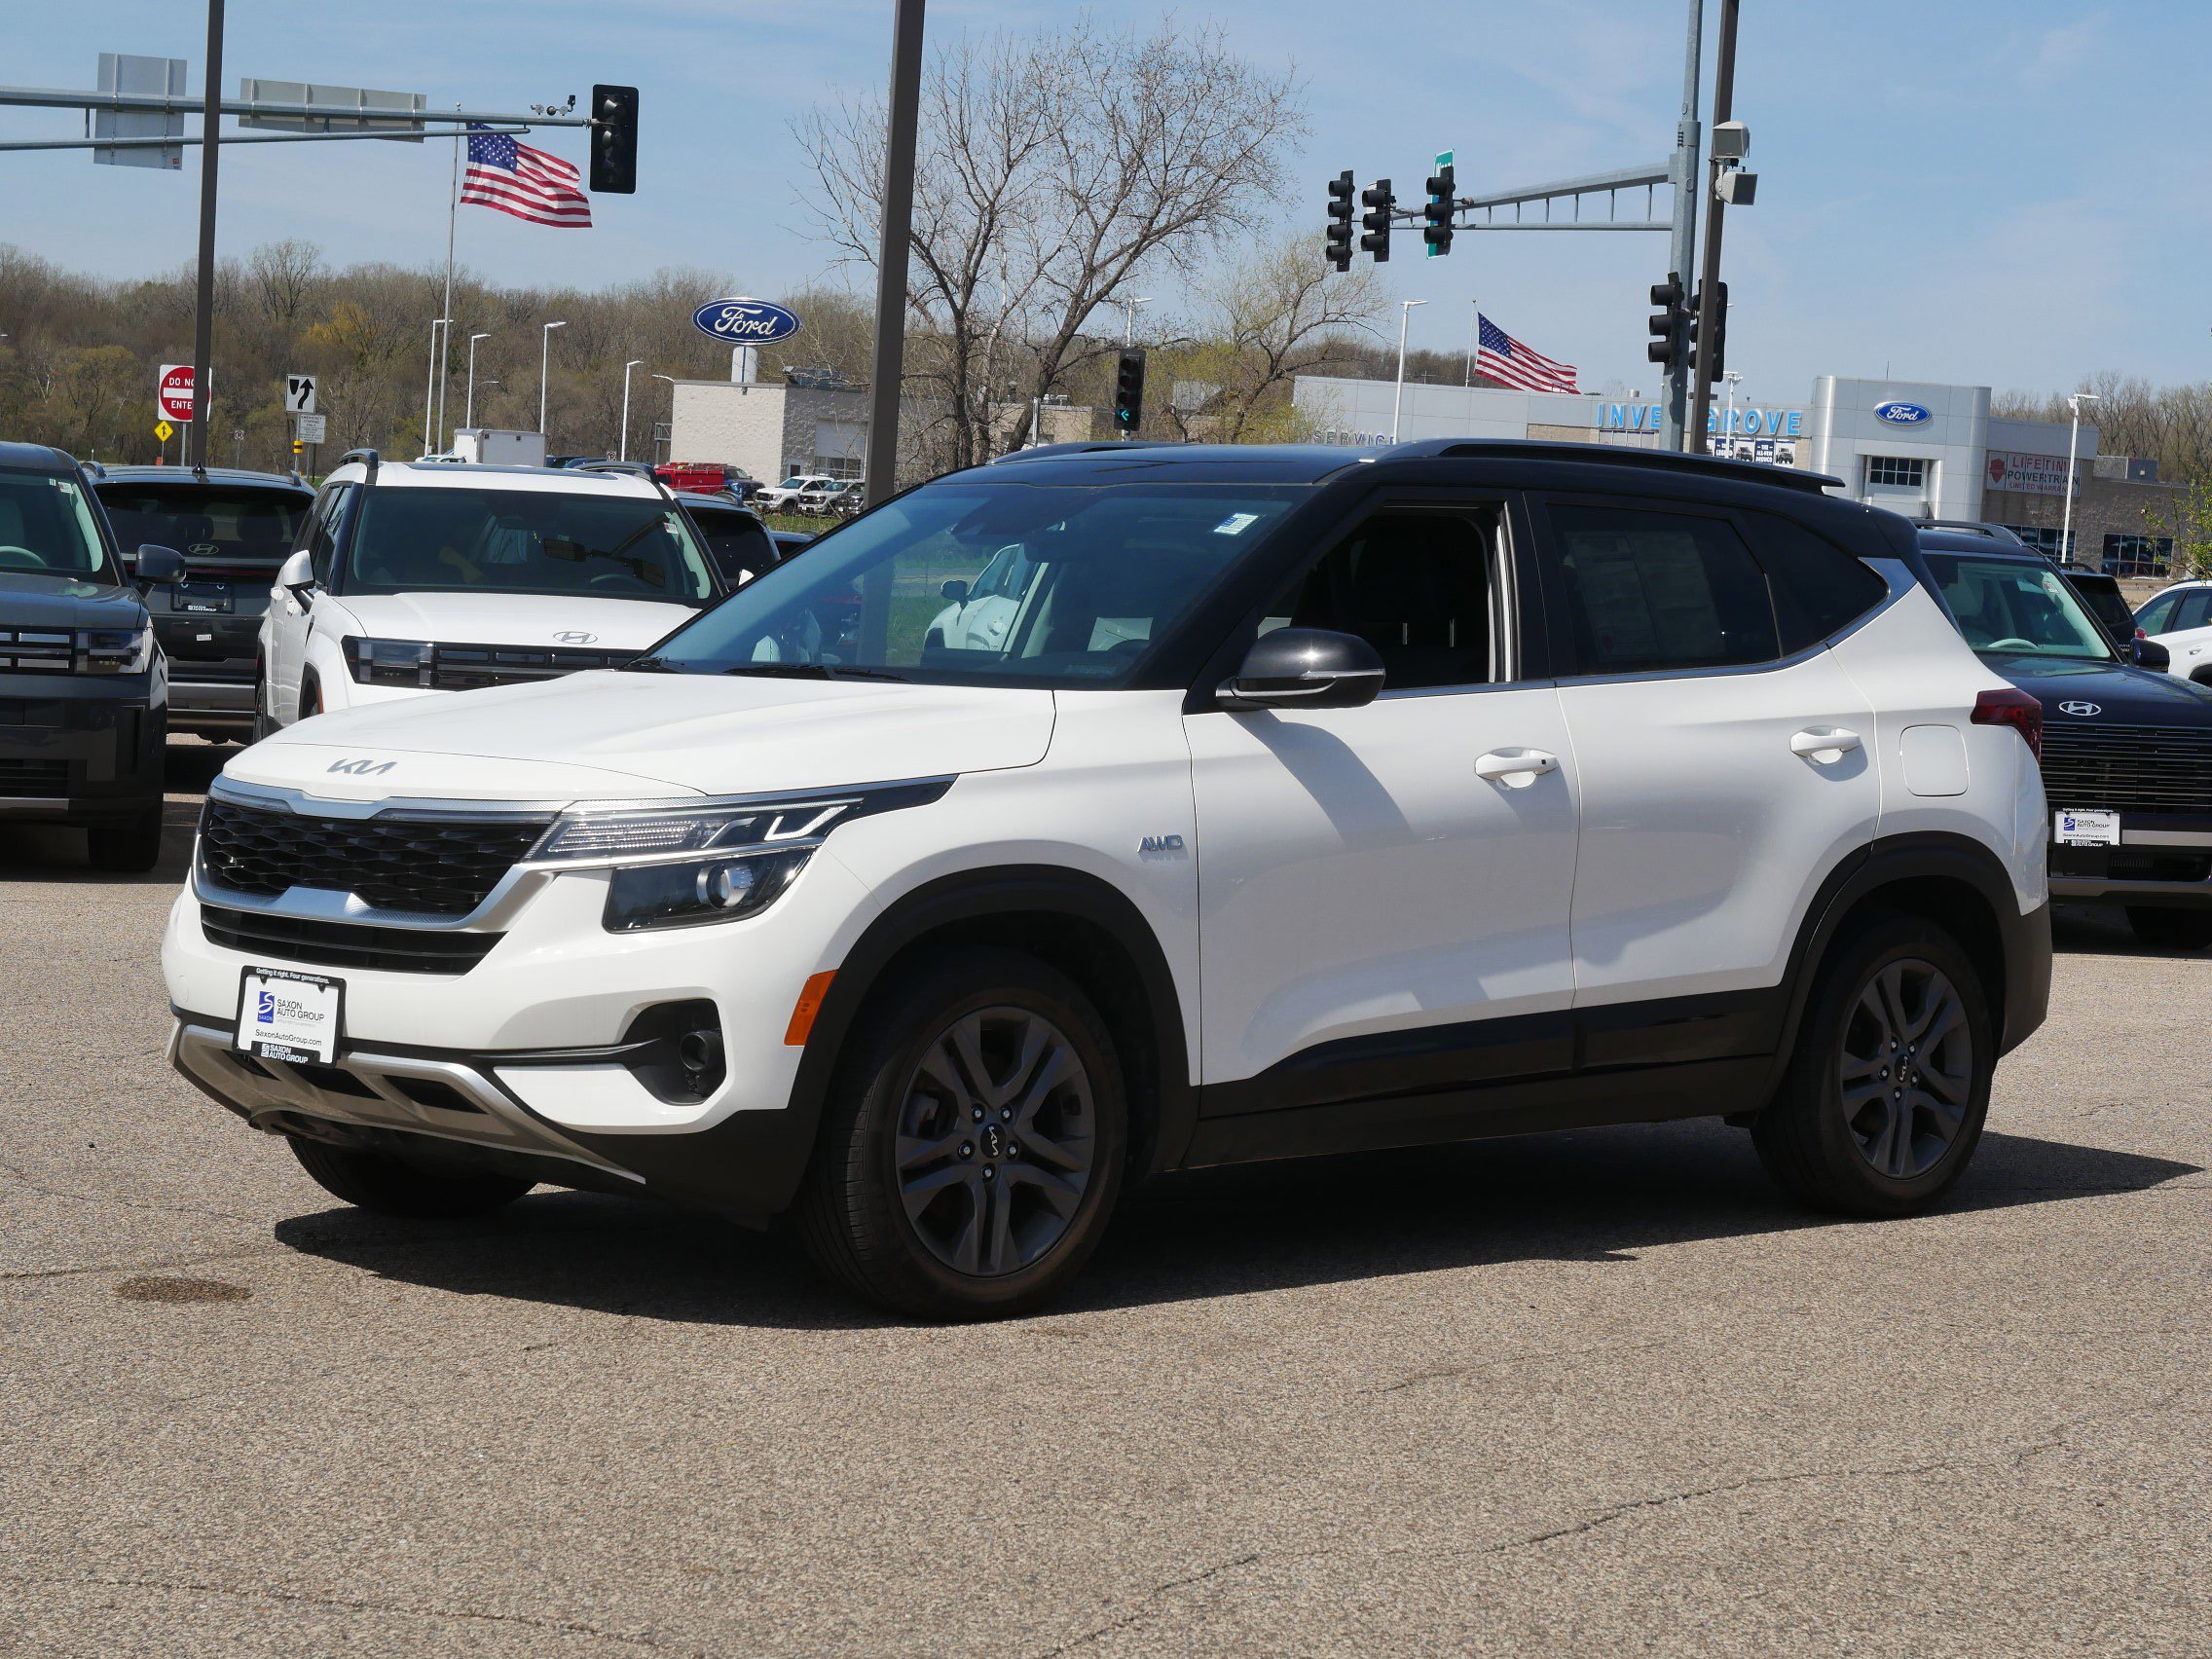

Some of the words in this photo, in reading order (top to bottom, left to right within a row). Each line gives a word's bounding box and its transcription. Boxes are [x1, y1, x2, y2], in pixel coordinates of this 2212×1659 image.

[715, 306, 778, 335] Ford
[168, 377, 181, 387] DO
[185, 378, 195, 387] NO
[171, 400, 193, 410] ENTE
[1597, 404, 1662, 428] INVE
[1707, 407, 1802, 435] GROVE
[1887, 406, 1919, 420] Ford
[2012, 457, 2076, 472] LIFETIM
[2008, 470, 2079, 486] POWERTRAN
[1137, 834, 1184, 853] AWD
[256, 967, 274, 977] Getting
[277, 999, 303, 1010] SAXON
[276, 1007, 296, 1017] AUTO
[297, 1011, 324, 1021] GROUP
[255, 1028, 322, 1046] SaxonAutoGroup.com
[270, 1044, 292, 1053] SAXON
[269, 1051, 286, 1060] AUTO
[286, 1054, 309, 1063] GROUP
